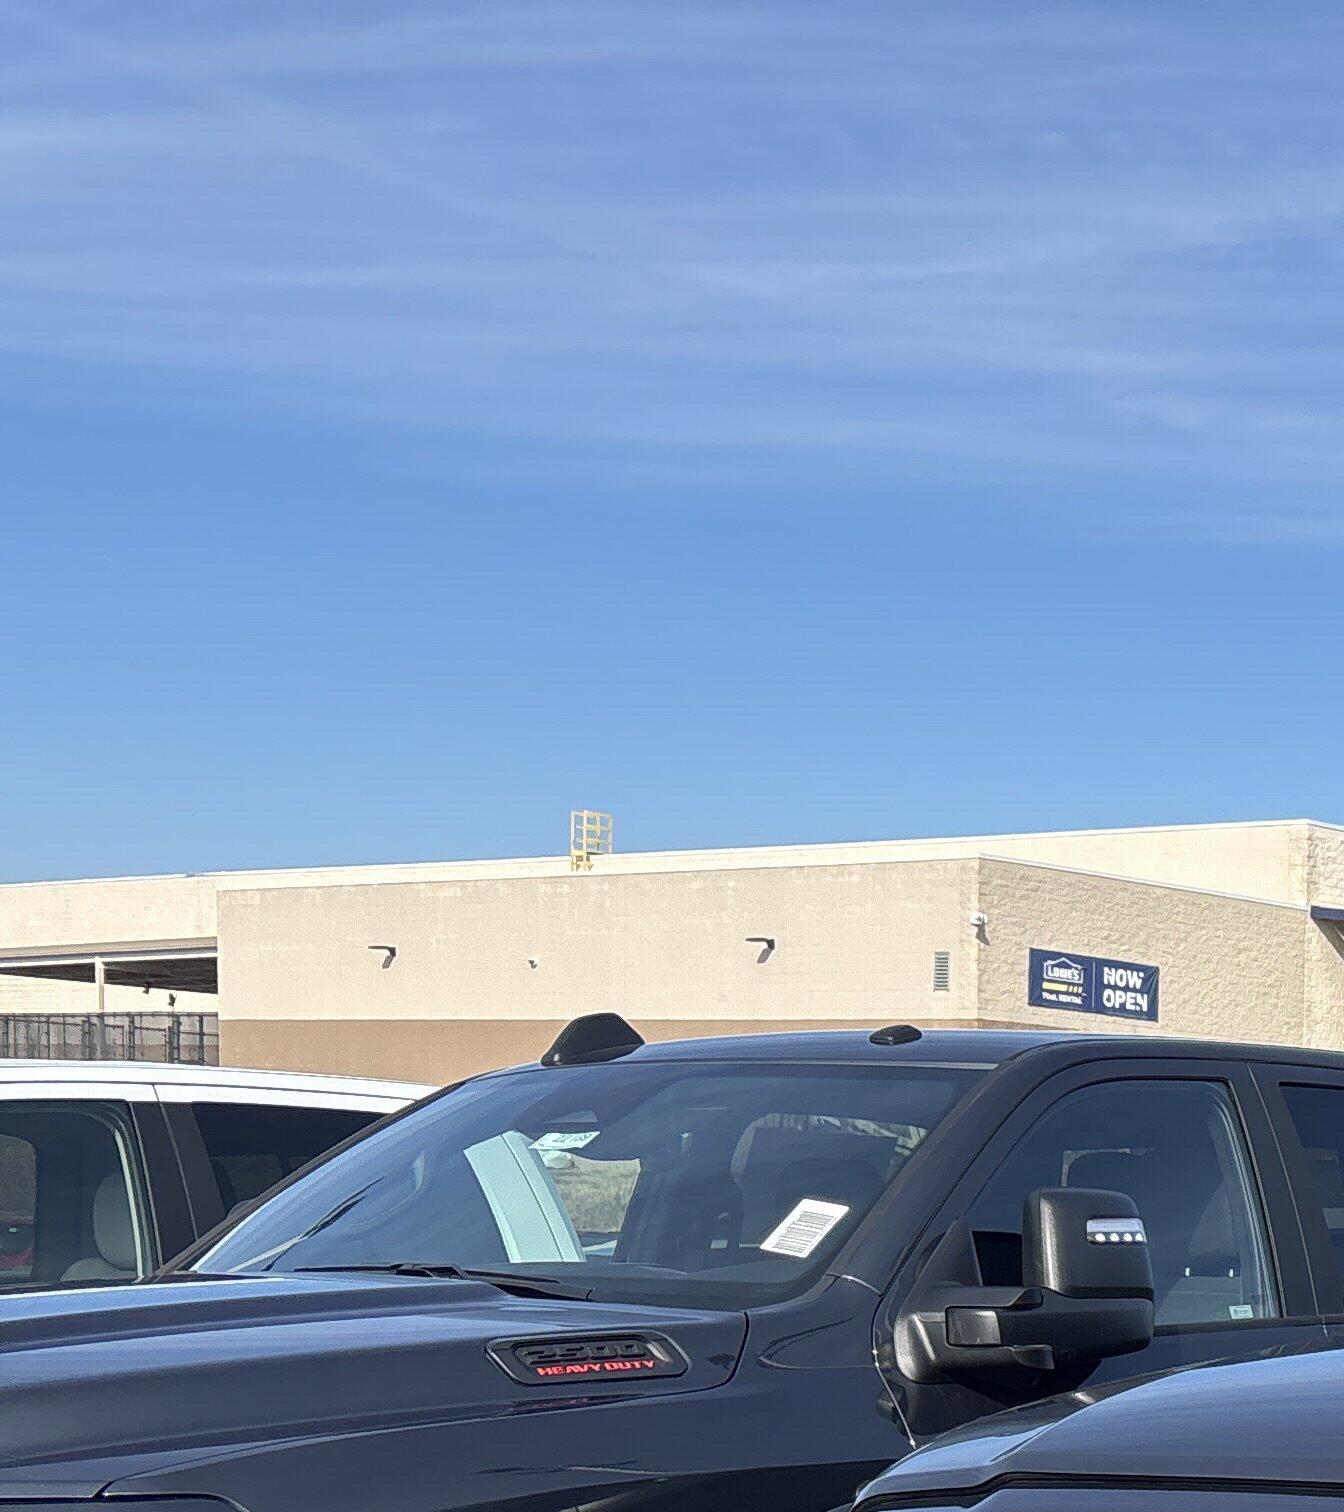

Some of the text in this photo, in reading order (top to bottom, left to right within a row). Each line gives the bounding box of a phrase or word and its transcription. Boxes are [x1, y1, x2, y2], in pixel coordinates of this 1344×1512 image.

[1103, 966, 1145, 990] NOW
[1103, 988, 1148, 1012] OPEN
[523, 1341, 646, 1366] 2500
[536, 1359, 656, 1377] HEAVY DUTY
